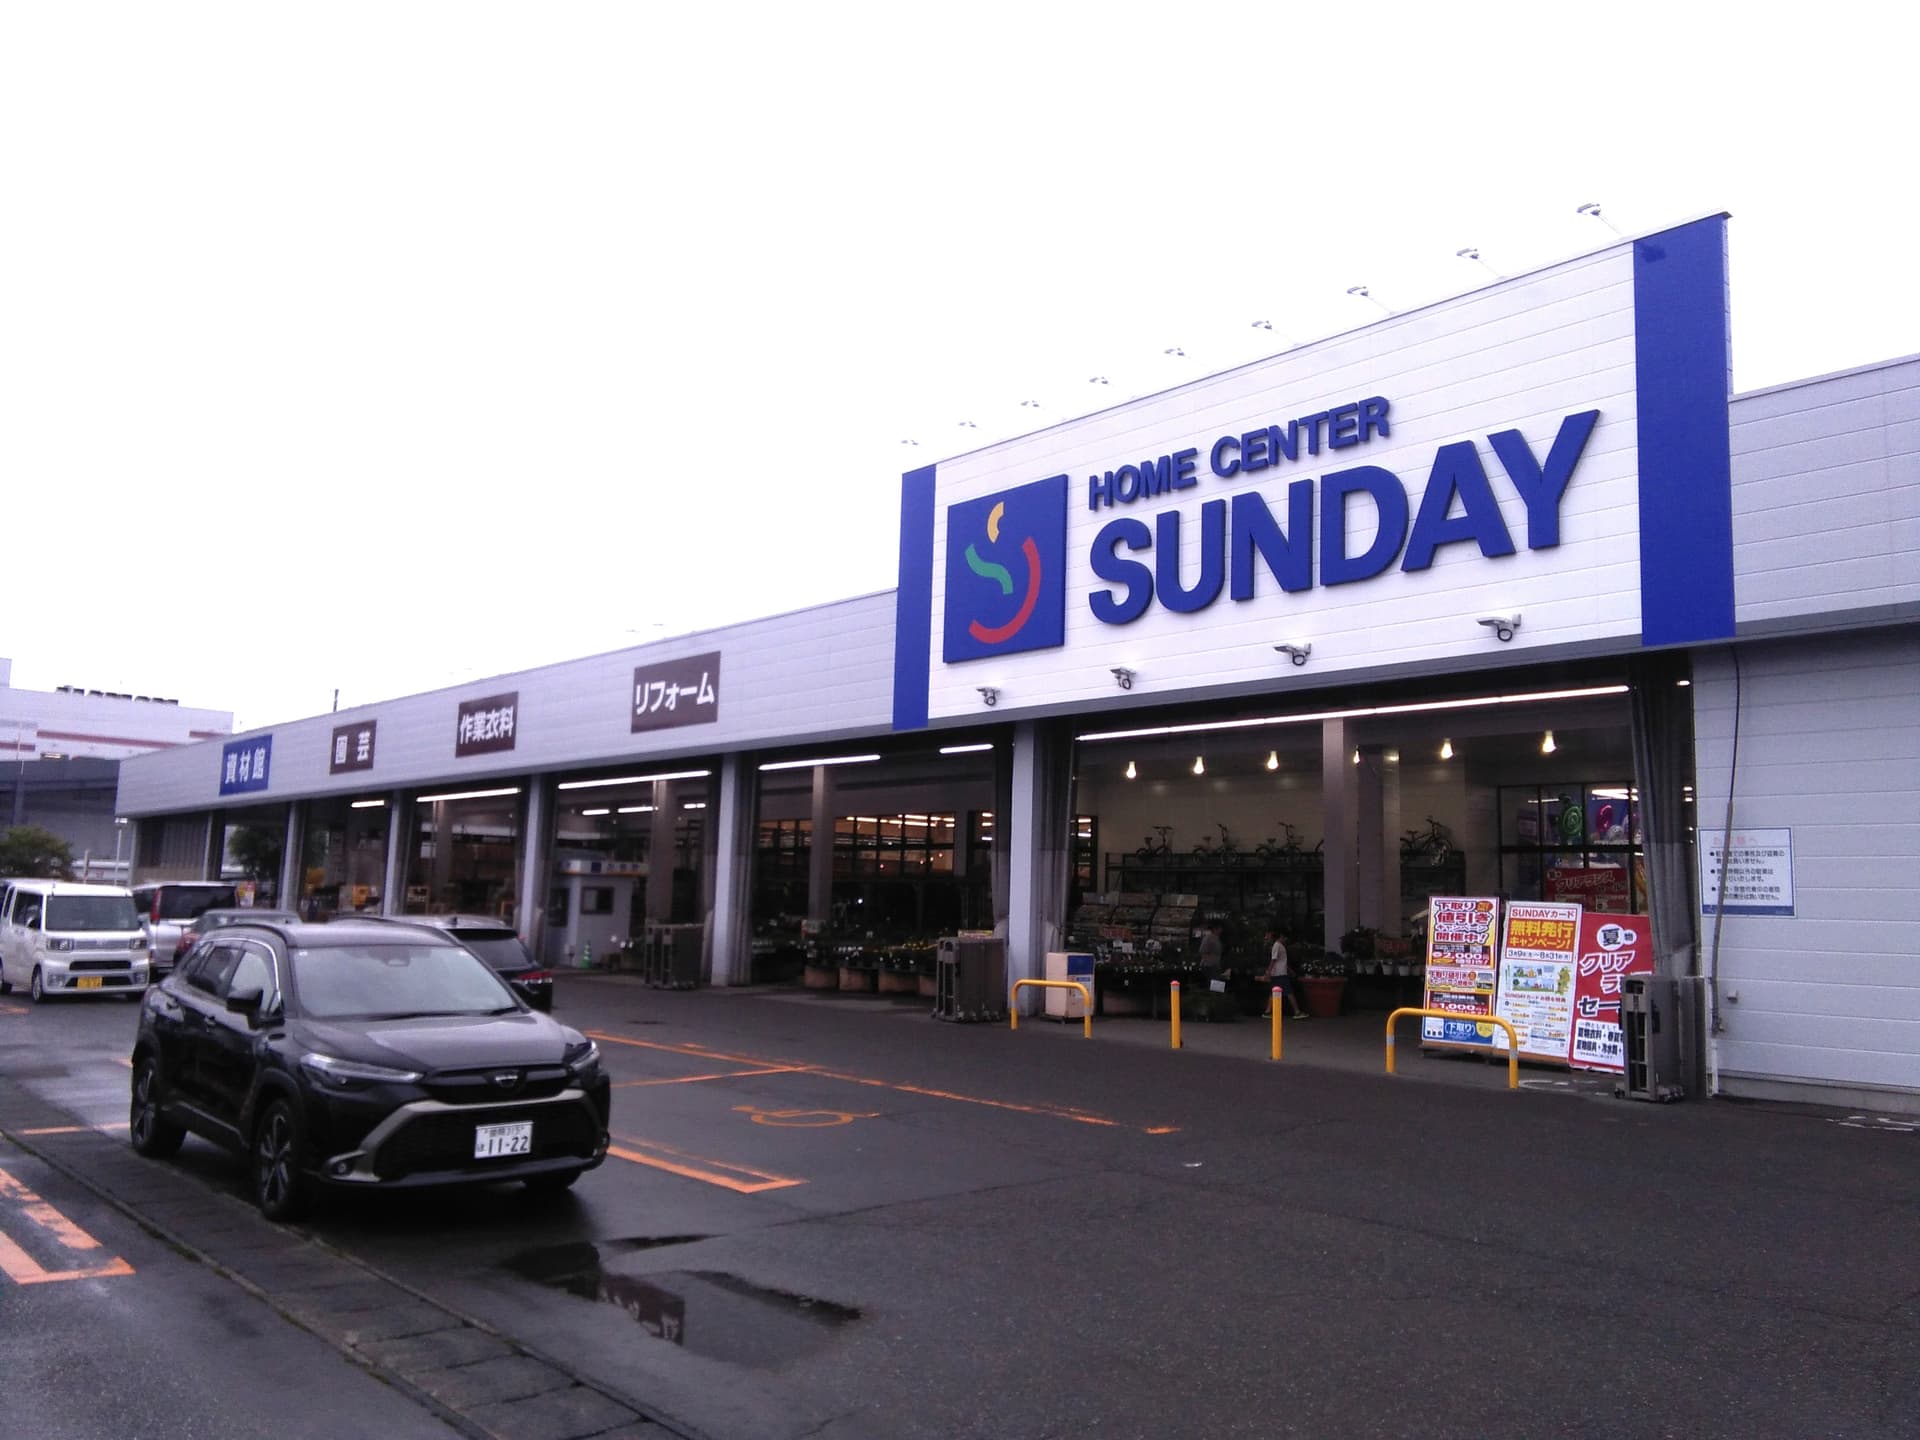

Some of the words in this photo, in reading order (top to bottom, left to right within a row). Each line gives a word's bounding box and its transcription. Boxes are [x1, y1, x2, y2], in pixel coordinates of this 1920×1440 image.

[1089, 447, 1197, 512] HOME
[1210, 396, 1390, 479] CENTER
[1089, 409, 1601, 625] SUNDAY
[635, 670, 716, 715] リフォーム
[459, 705, 515, 745] 作業衣料
[335, 730, 371, 765] 園芸
[224, 746, 266, 785] 資材館
[1435, 901, 1476, 911] 下取り
[1435, 911, 1493, 924] 値引き
[1511, 908, 1575, 919] SUNDAYカード
[1510, 920, 1574, 938] 無料発行
[488, 1136, 528, 1155] 11-22
